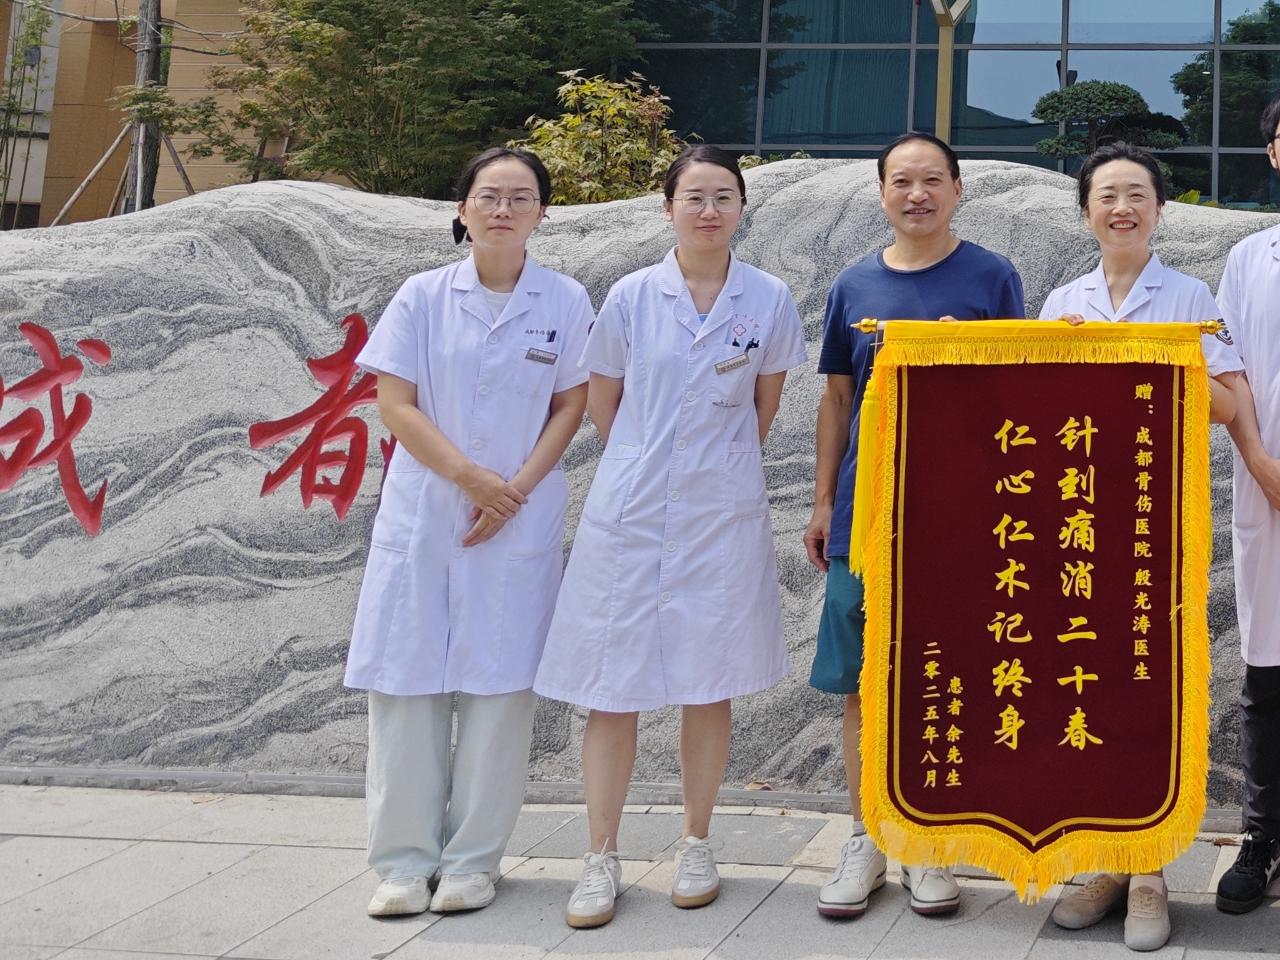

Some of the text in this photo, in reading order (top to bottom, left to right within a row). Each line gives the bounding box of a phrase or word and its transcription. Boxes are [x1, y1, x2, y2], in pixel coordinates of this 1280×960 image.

[920, 641, 942, 788] 二零二五年八月
[986, 418, 1037, 752] 仁心仁术记终身
[1054, 415, 1104, 752] 针到痛消二十春
